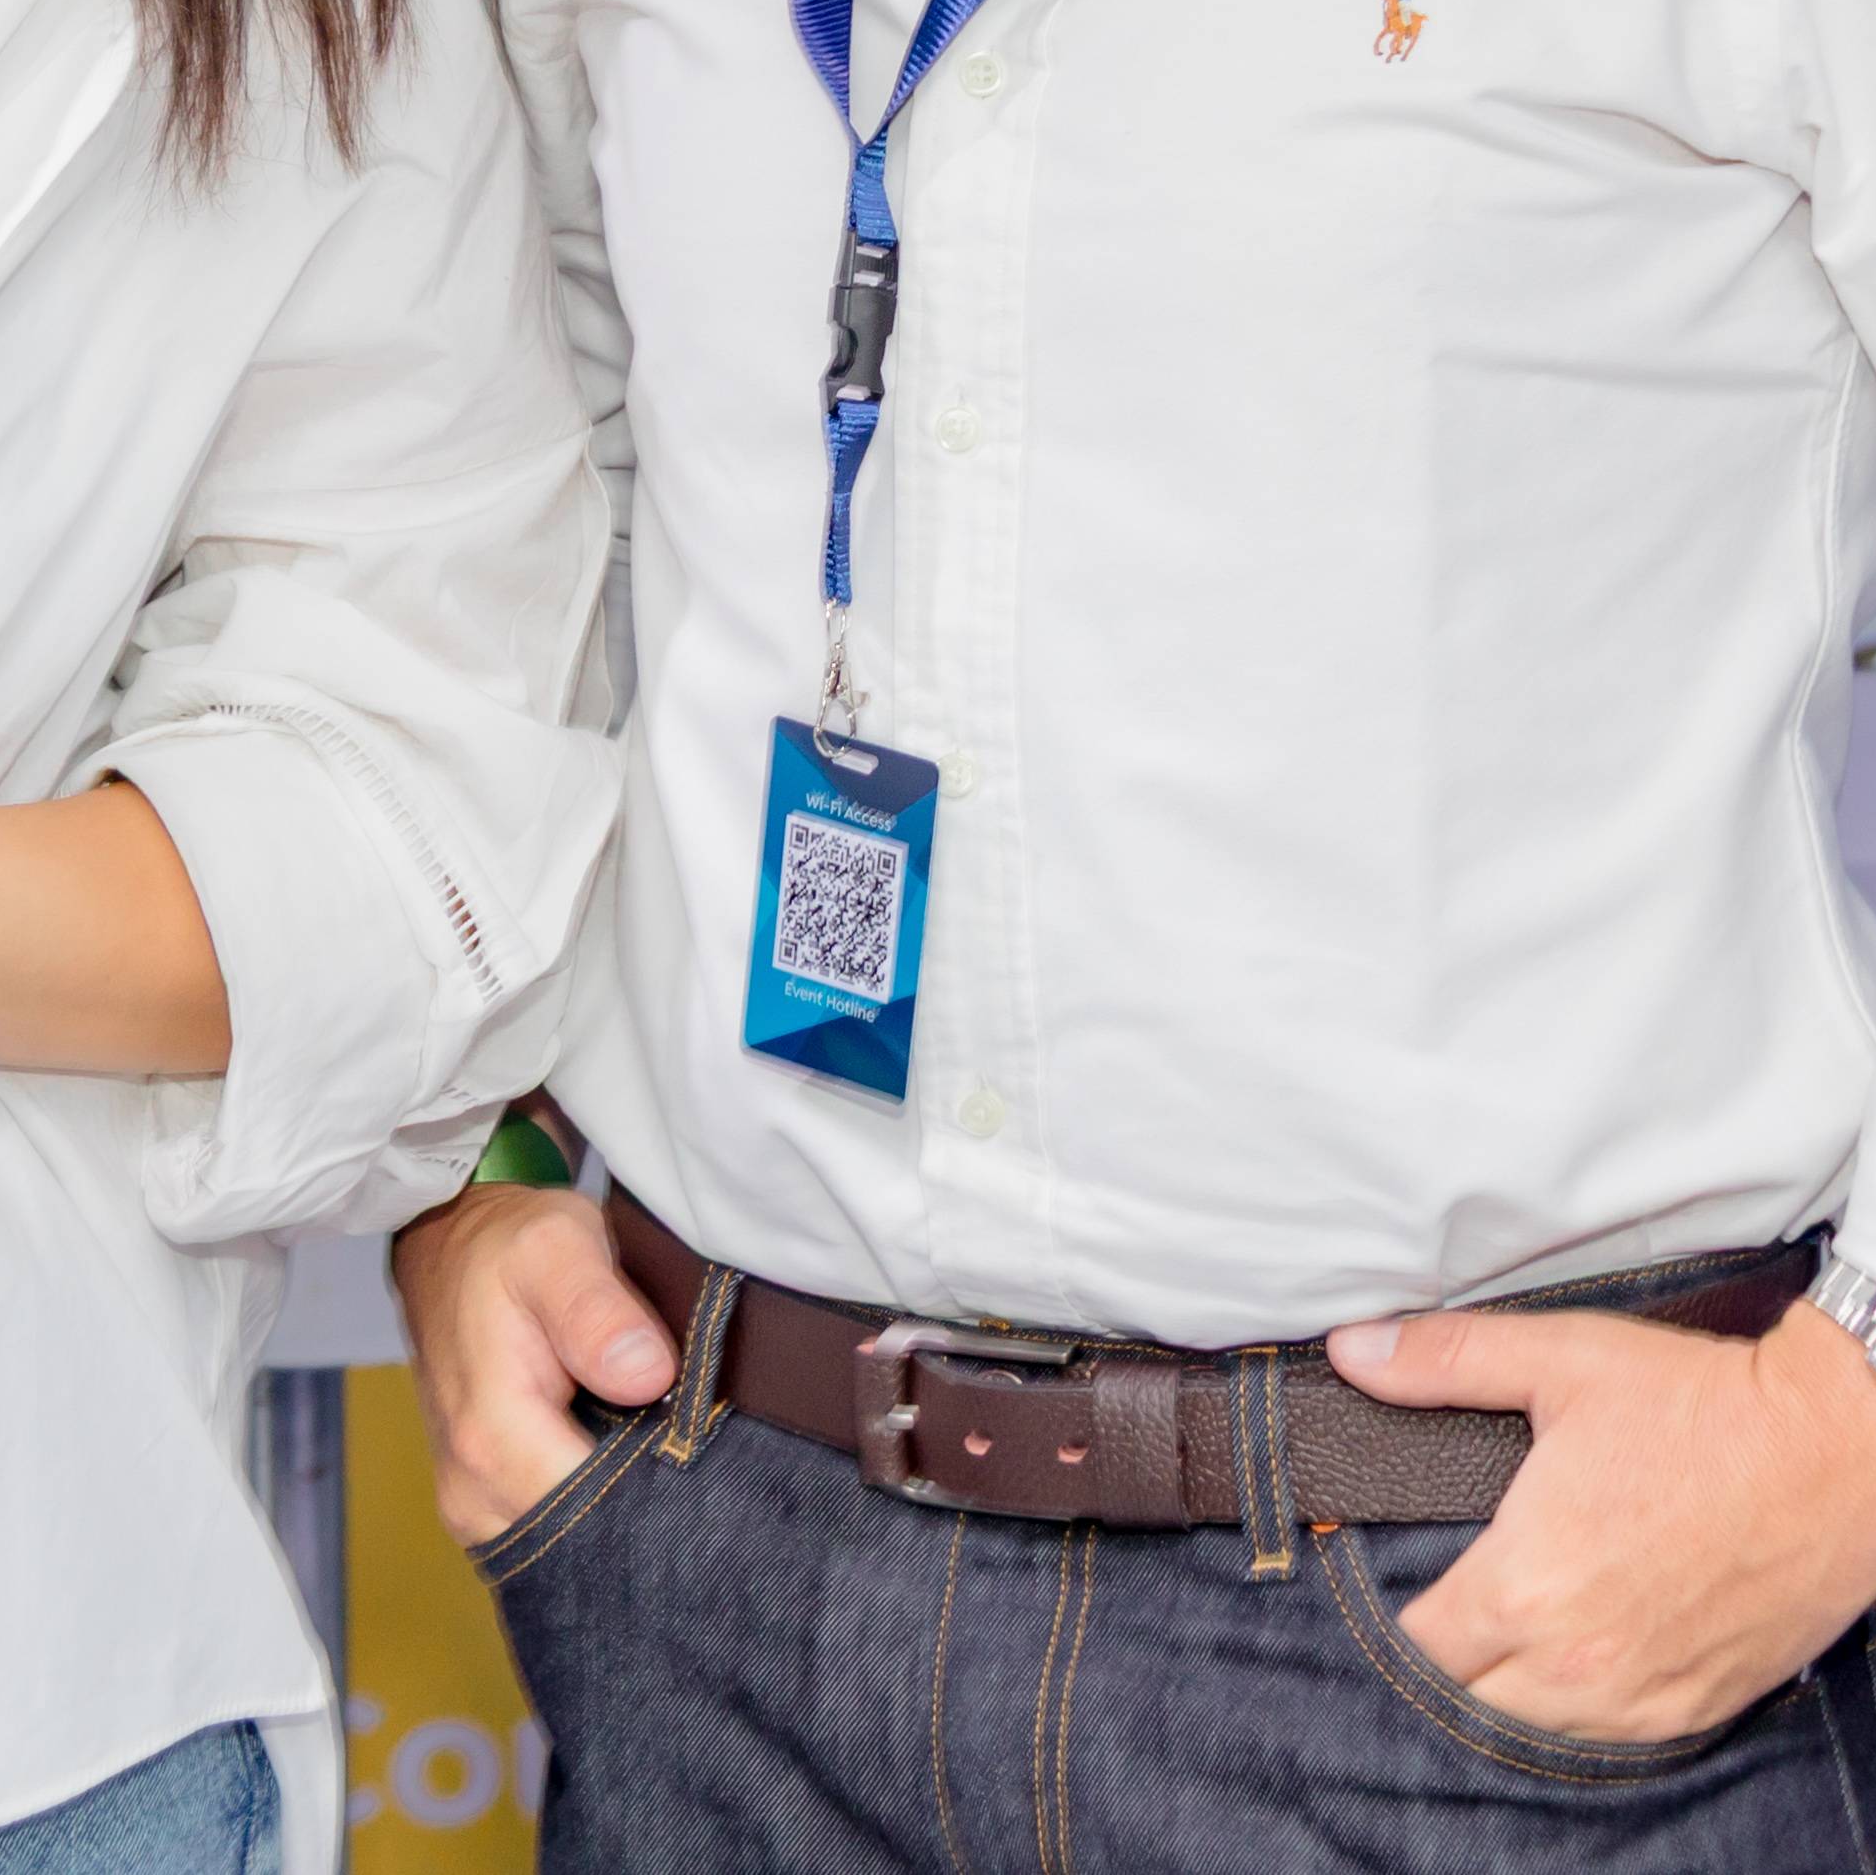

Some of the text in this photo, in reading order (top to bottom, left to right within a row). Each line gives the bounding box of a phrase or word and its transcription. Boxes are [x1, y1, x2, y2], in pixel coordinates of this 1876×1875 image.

[843, 805, 895, 832] Access
[784, 980, 878, 1024] Event Hotline
